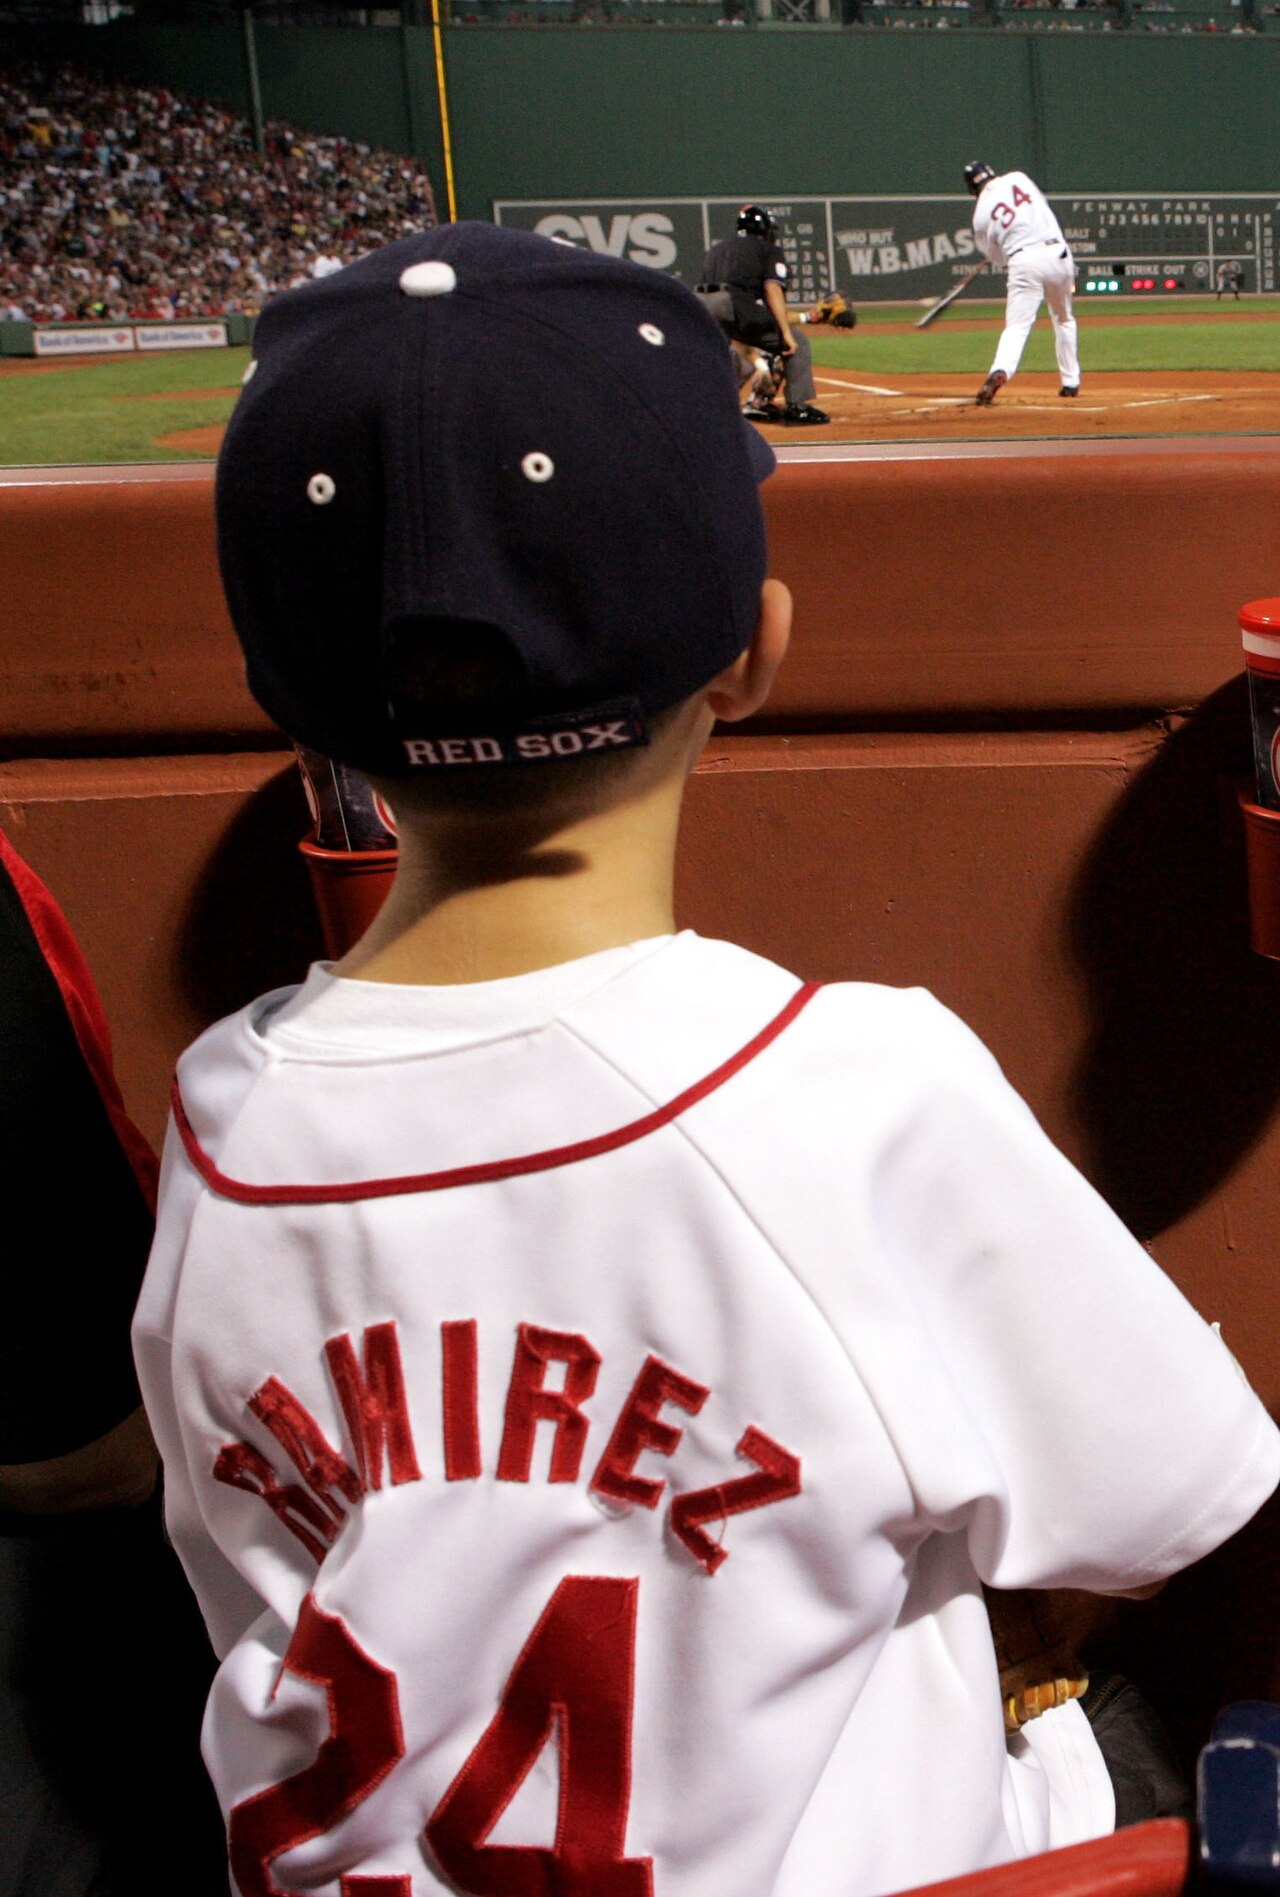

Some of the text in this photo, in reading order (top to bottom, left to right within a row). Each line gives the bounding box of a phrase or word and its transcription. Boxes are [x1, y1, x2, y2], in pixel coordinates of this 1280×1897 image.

[991, 185, 1032, 229] 34
[1072, 202, 1211, 212] FENWAY PARK
[1109, 213, 1117, 224] 2
[1118, 213, 1126, 224] 3
[1131, 213, 1139, 224] 4
[1142, 213, 1149, 224] 5
[1151, 213, 1159, 224] 6
[1165, 213, 1172, 224] 7
[1196, 213, 1206, 224] 10
[834, 229, 894, 246] WHO BUT
[846, 228, 974, 276] W.B.MAS
[1069, 243, 1097, 252] STON
[1088, 265, 1113, 276] BALL
[1125, 265, 1159, 276] STRIKE
[1163, 265, 1185, 275] OUT
[403, 720, 632, 765] RED SOX
[213, 1319, 801, 1575] RAMIREZ
[230, 1575, 654, 1897] 24
